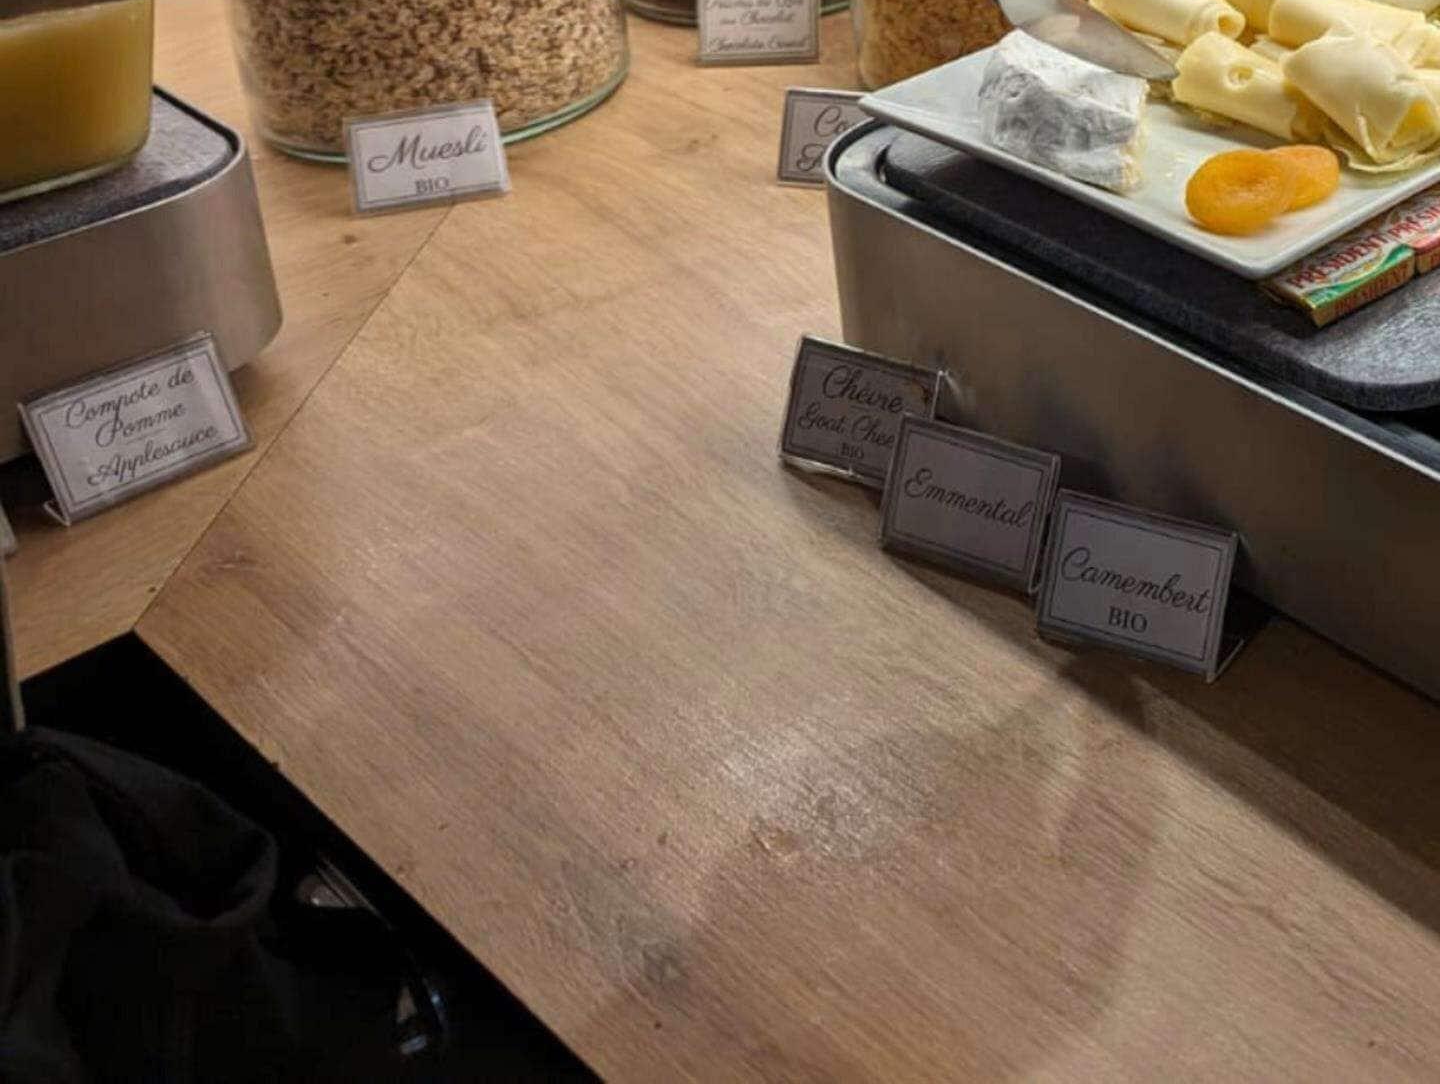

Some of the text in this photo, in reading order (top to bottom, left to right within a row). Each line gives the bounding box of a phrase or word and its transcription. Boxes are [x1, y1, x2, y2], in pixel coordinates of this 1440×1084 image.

[367, 124, 489, 174] Muesli
[414, 175, 451, 196] BIO
[65, 366, 195, 435] Compote de
[798, 402, 845, 434] Goat
[95, 402, 187, 448] Pomme
[87, 424, 218, 487] Applesauce
[840, 442, 864, 460] BIO
[905, 467, 1034, 529] Emmental
[1060, 546, 1211, 615] Camembert
[1107, 606, 1149, 634] BIO
